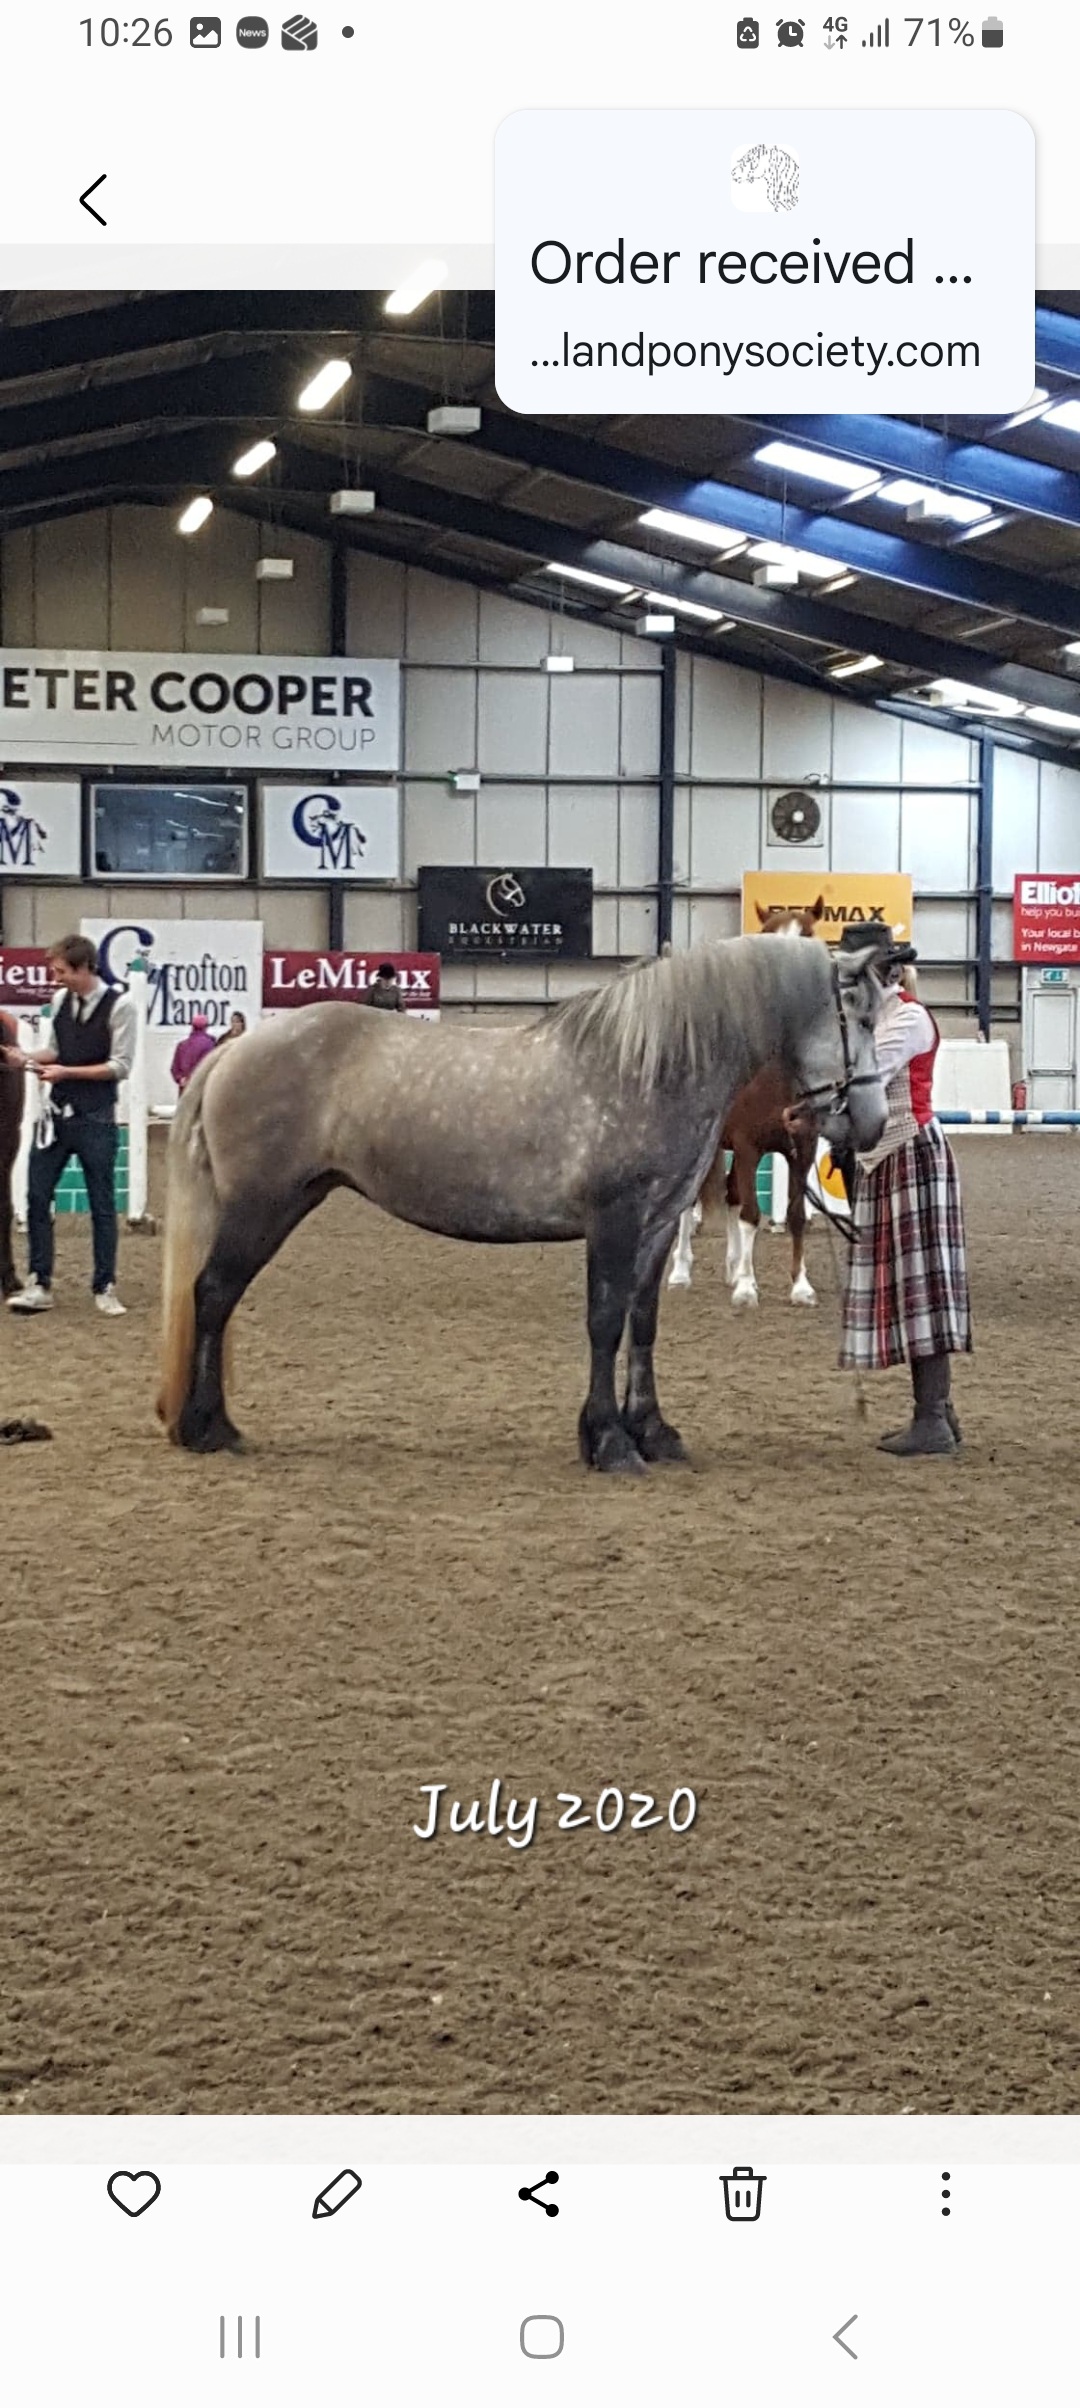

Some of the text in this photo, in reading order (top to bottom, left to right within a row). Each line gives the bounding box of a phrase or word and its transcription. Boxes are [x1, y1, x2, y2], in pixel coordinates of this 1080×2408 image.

[80, 18, 172, 47] 10:26
[239, 28, 267, 38] News
[823, 16, 848, 32] 4G
[904, 17, 975, 47] 71%
[532, 237, 681, 285] Order
[699, 237, 913, 285] received
[3, 667, 374, 718] ETER COOPER
[152, 723, 376, 751] MOTOR GROUP
[1044, 909, 1063, 920] you
[1065, 908, 1080, 918] bu
[448, 922, 563, 935] BLACKWATER
[1021, 927, 1045, 939] Your
[1021, 941, 1031, 952] in
[147, 963, 231, 1027] Manor
